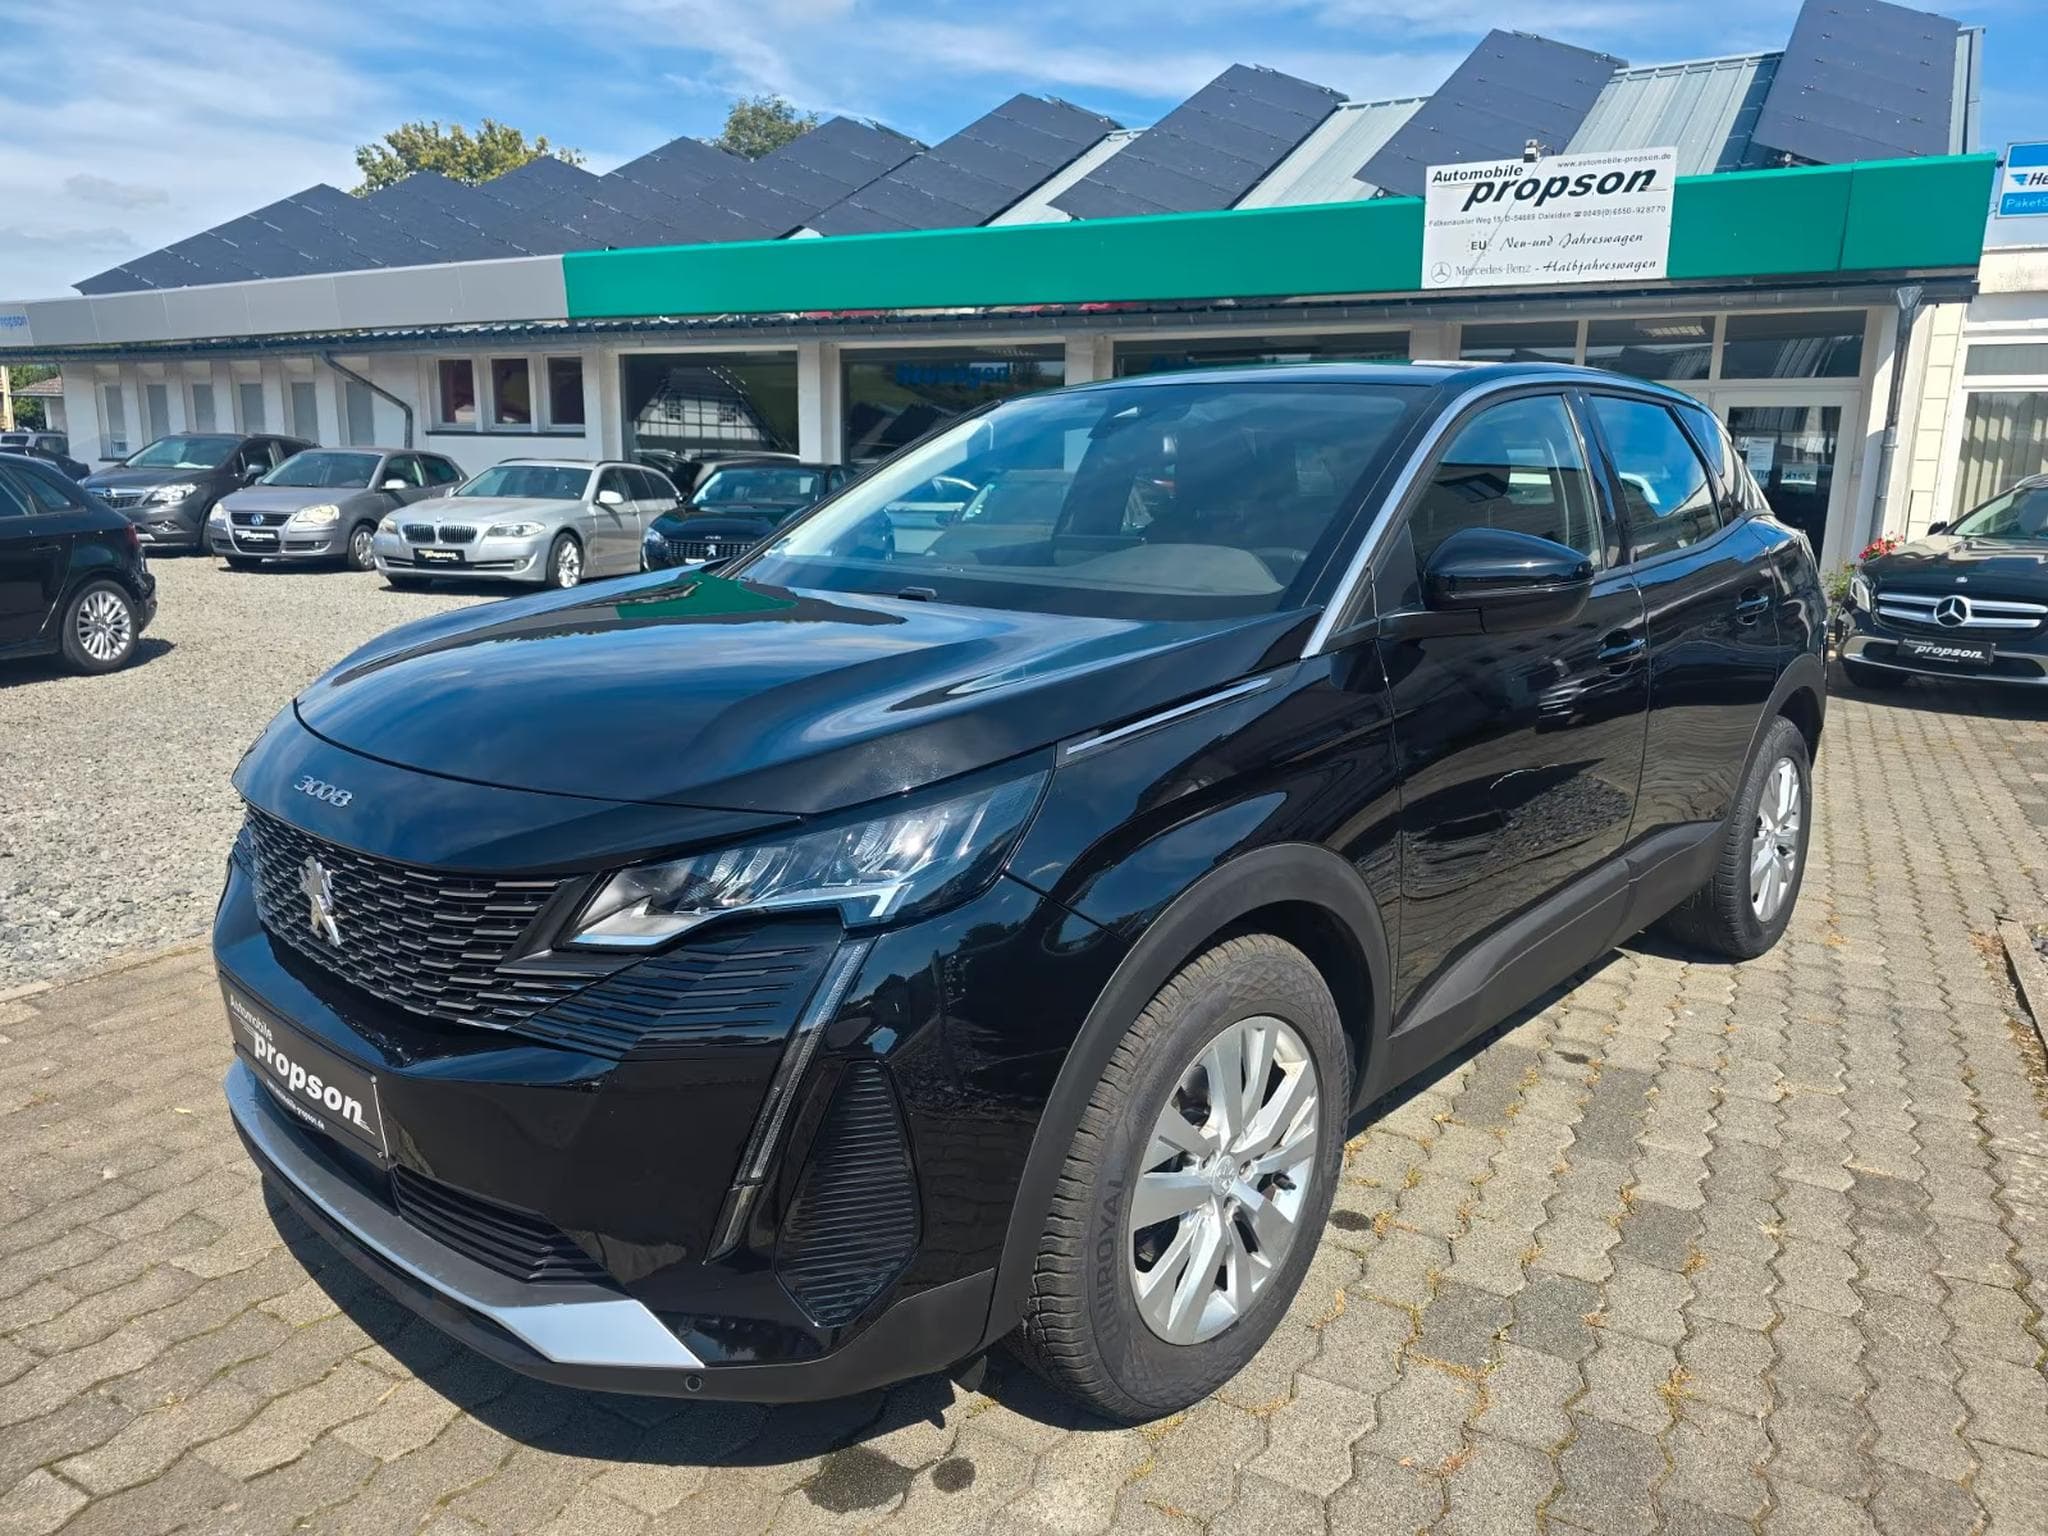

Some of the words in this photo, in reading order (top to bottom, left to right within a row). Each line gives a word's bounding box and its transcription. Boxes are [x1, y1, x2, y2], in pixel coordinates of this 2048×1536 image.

[1557, 153, 1672, 168] www.automobile-propson.de
[1432, 165, 1523, 183] Automobile
[1461, 168, 1657, 212] propson
[1475, 215, 1491, 225] Weg
[1471, 240, 1487, 250] EU
[1559, 232, 1643, 248] Jahreswagen
[1543, 259, 1656, 275] Halbjahreswagen
[1914, 645, 1983, 658] propson
[294, 775, 353, 807] 3008
[254, 1032, 366, 1126] propson
